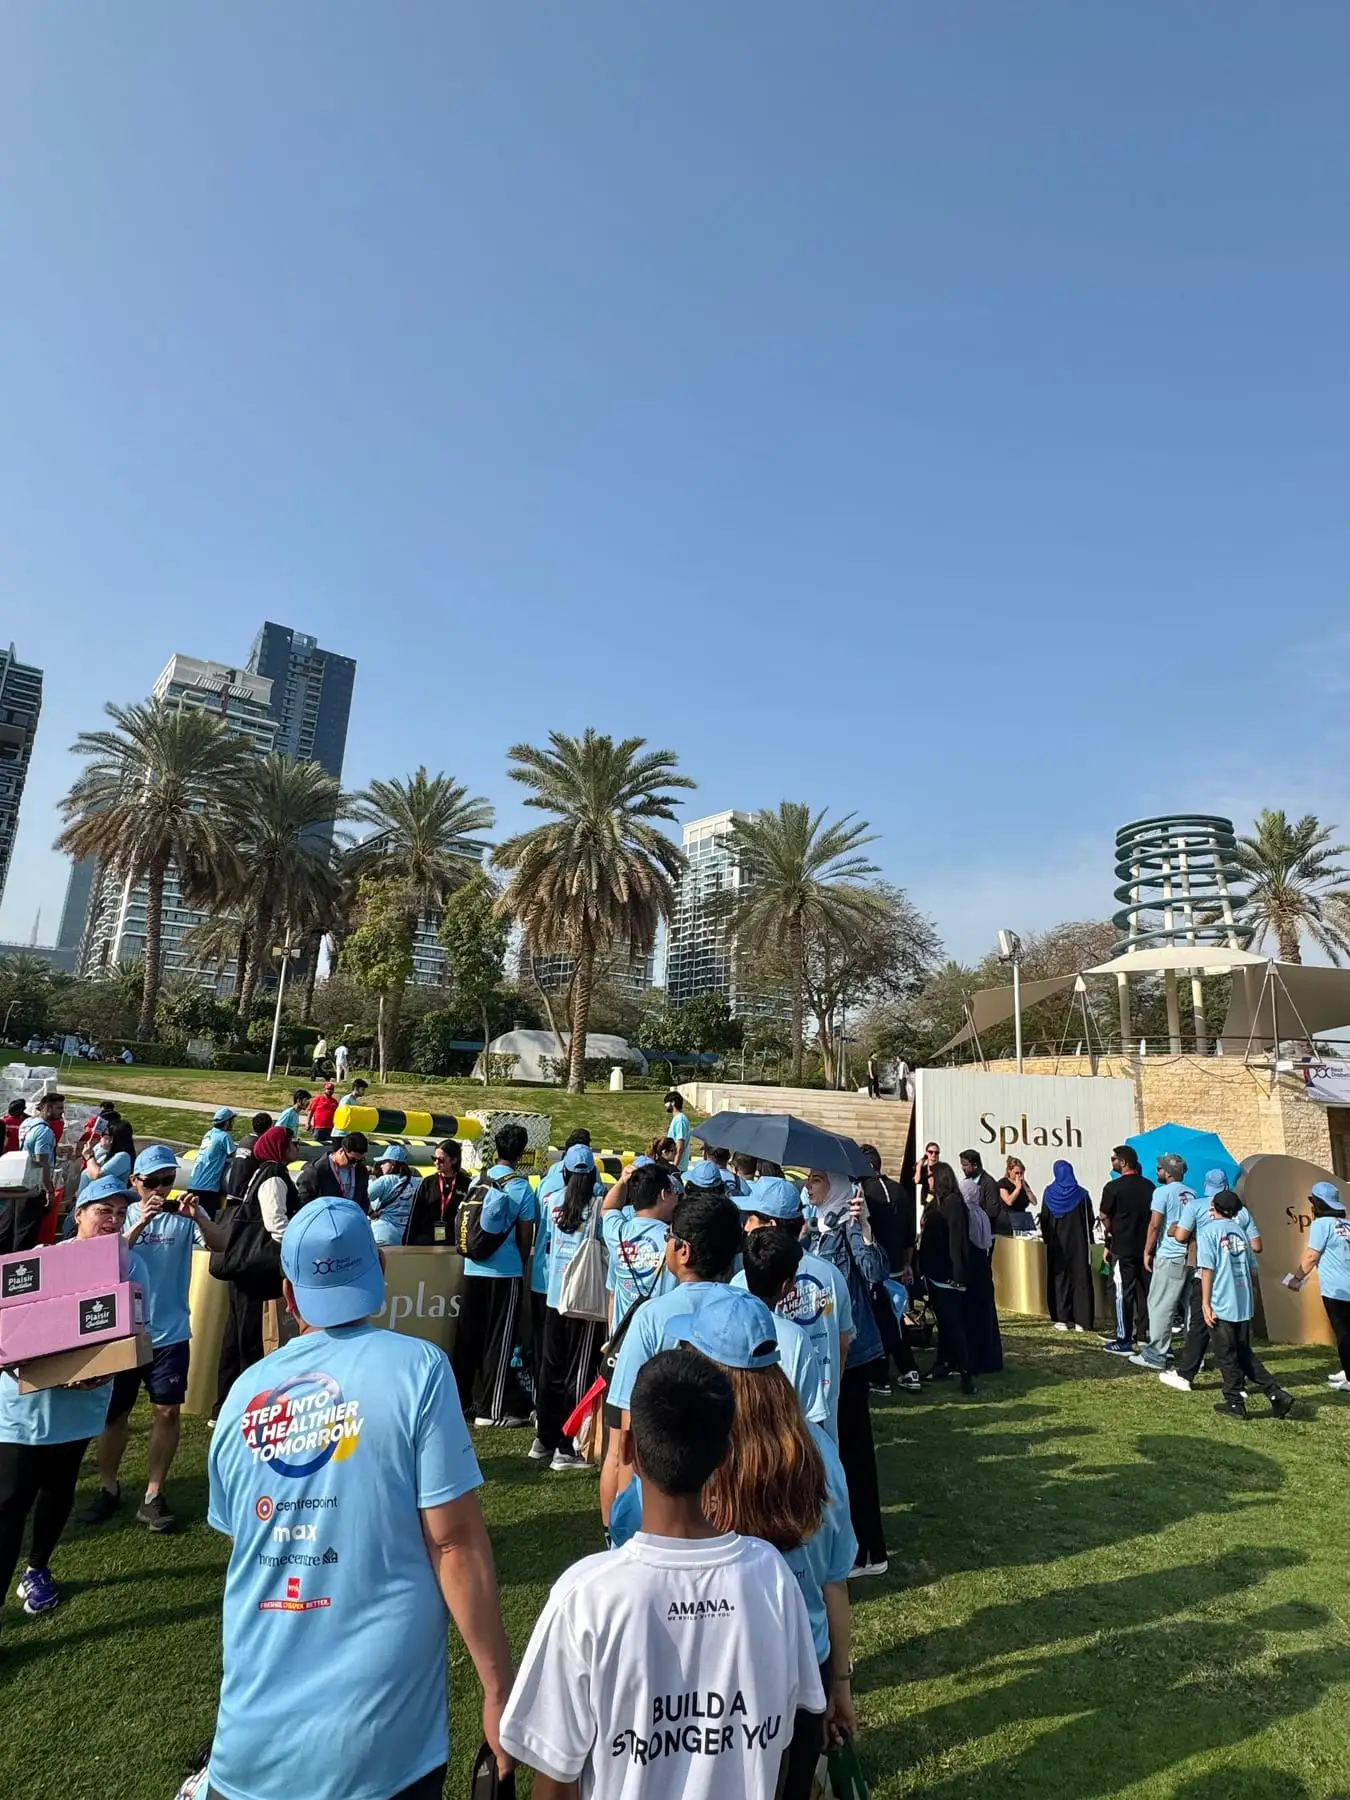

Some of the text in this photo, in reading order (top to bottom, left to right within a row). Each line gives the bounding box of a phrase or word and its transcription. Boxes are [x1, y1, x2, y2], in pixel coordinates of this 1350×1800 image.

[980, 1113, 1082, 1154] Splash
[8, 1275, 34, 1286] Plaisir
[85, 1311, 110, 1322] Plaisir
[241, 1391, 330, 1430] STEP INTO
[245, 1400, 359, 1448] A HEALTHIER
[252, 1417, 364, 1465] TOMORROW
[276, 1496, 338, 1511] centrepoint
[273, 1524, 318, 1543] max
[257, 1552, 321, 1567] homecentre
[653, 1690, 748, 1726] BUILD A
[612, 1725, 734, 1766] STRONGER
